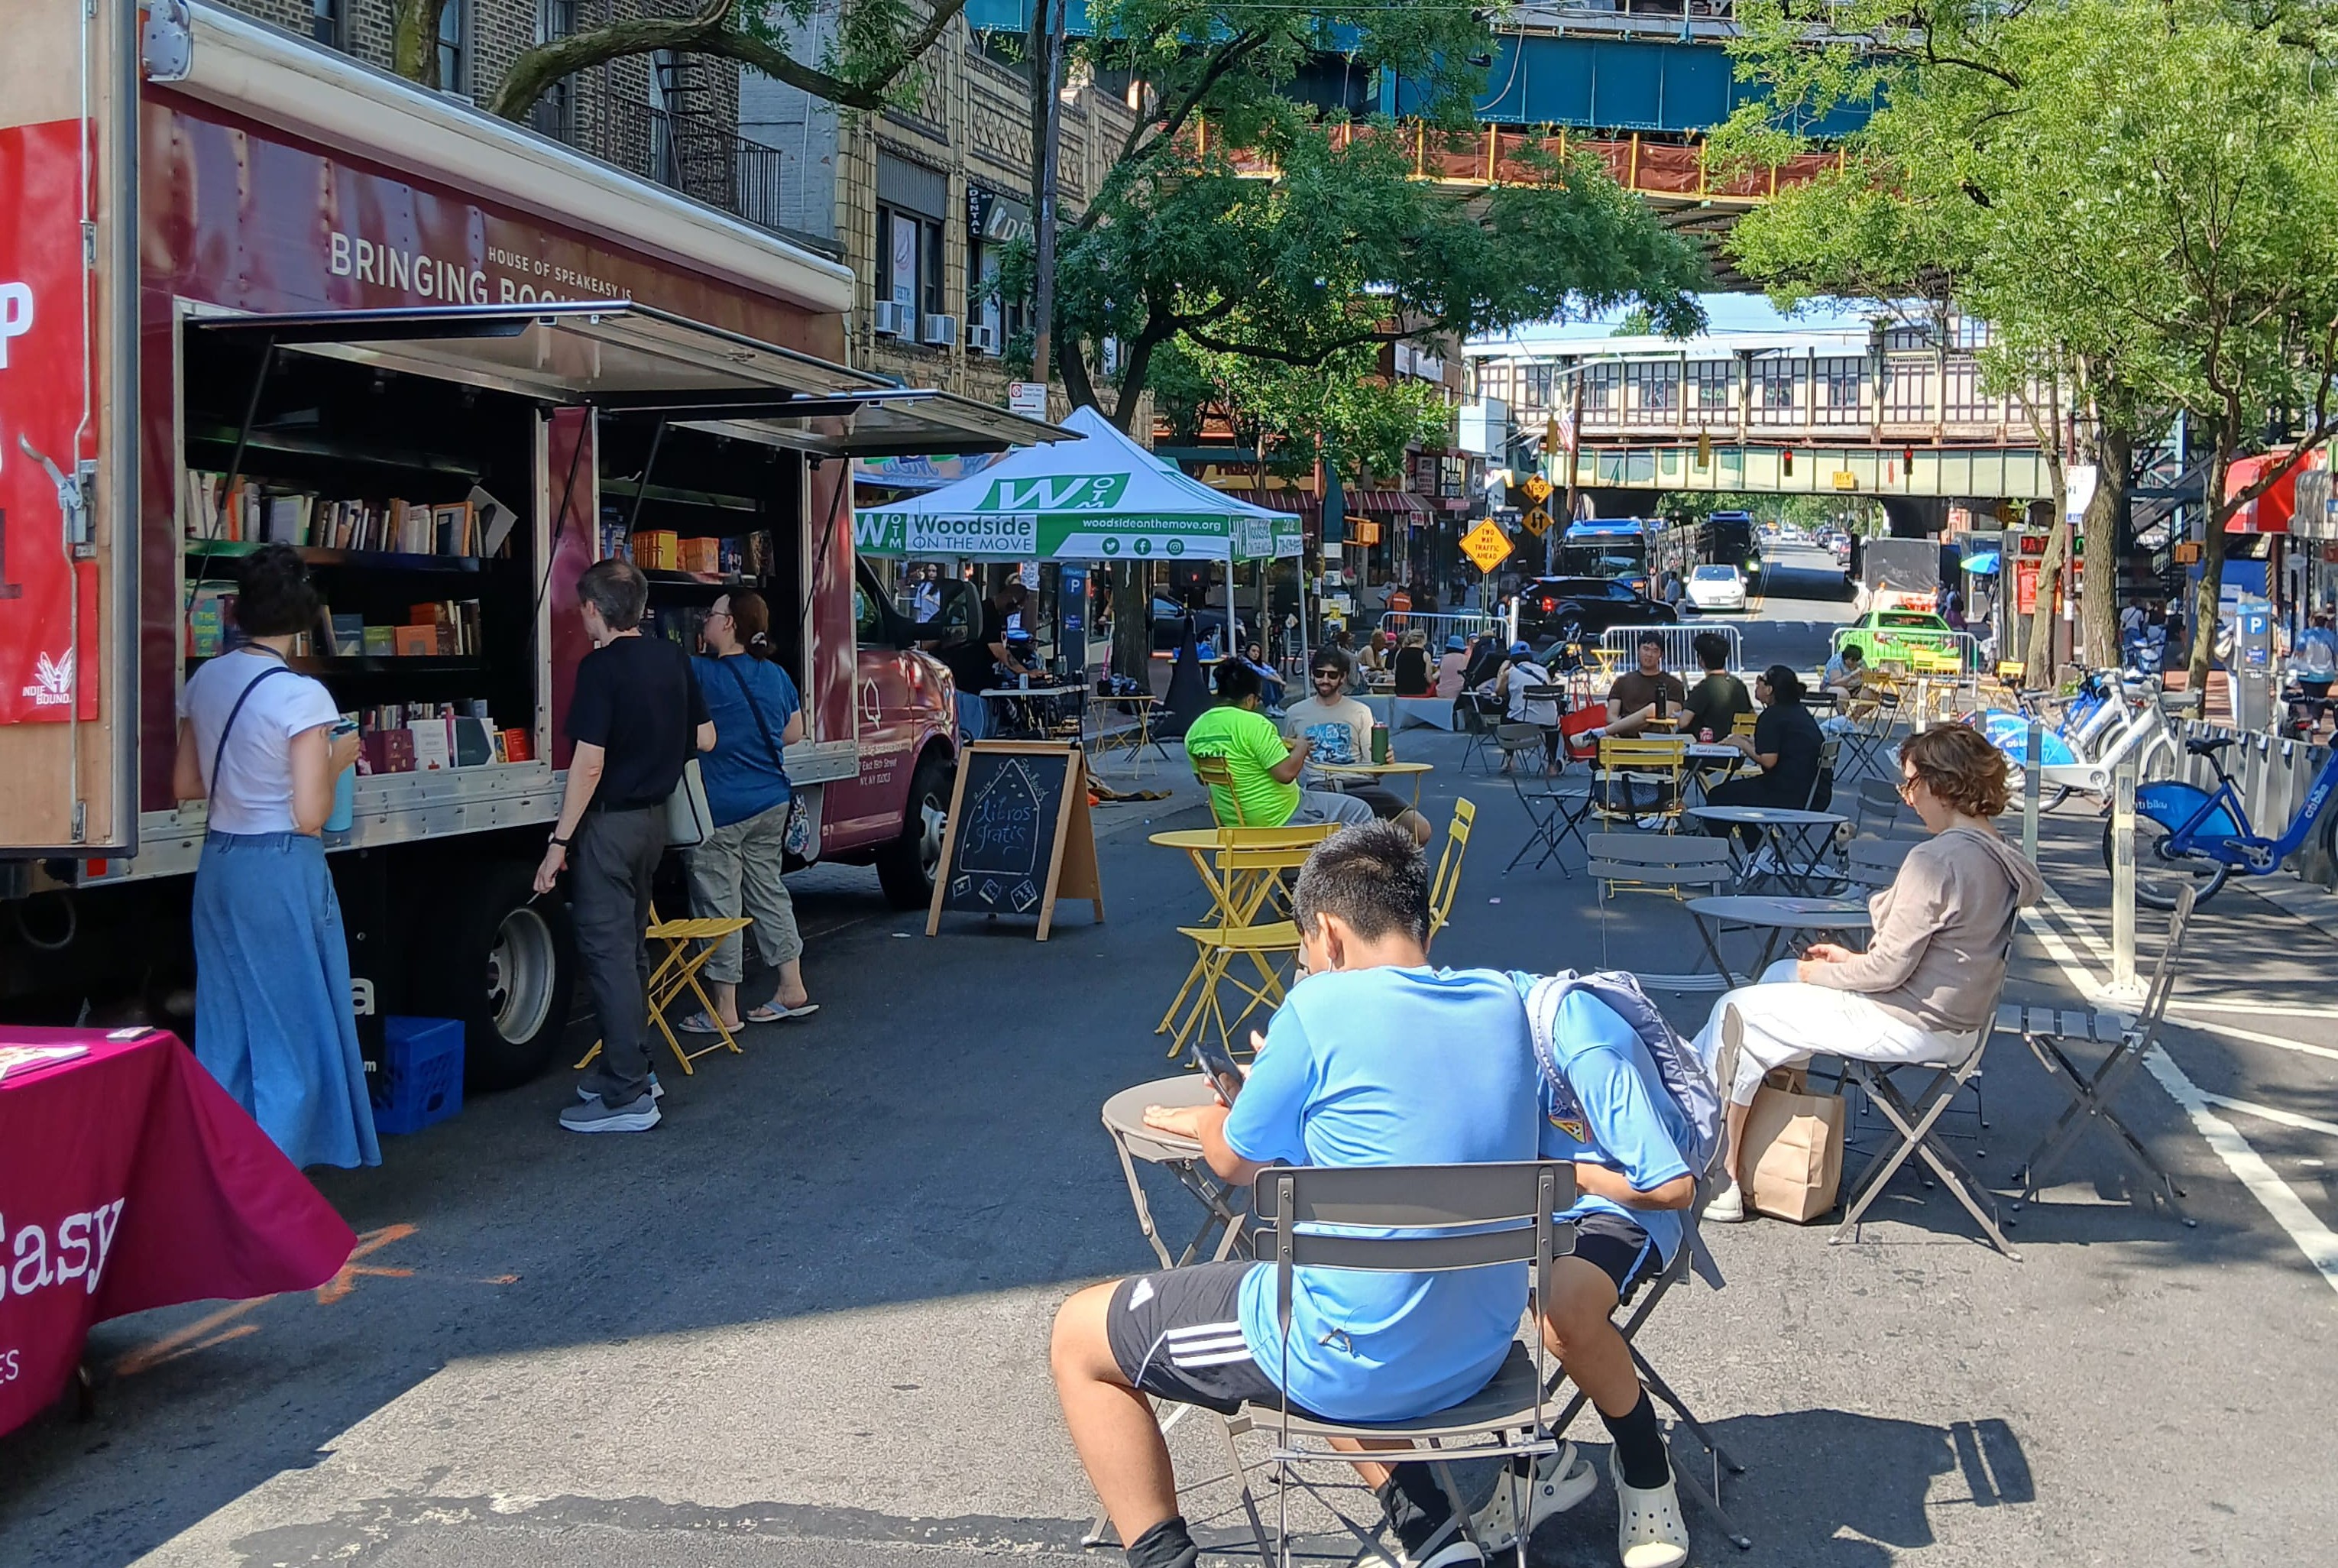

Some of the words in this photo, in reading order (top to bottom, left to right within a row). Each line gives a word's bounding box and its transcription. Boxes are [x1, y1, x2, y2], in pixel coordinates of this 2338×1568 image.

[969, 189, 980, 234] DENTAL
[331, 232, 487, 305] BRINGING
[488, 247, 529, 272] HOUSE
[535, 261, 550, 277] OF
[555, 267, 617, 297] SPEAKEASY
[622, 287, 632, 300] IS
[915, 515, 1031, 535] Woodside
[1083, 517, 1222, 532] woodsideonthemove.org
[913, 537, 939, 549] ON
[945, 537, 973, 549] THE
[980, 538, 1031, 550] MOVE
[1071, 578, 1080, 592] P
[2251, 617, 2262, 633] P
[22, 685, 46, 697] INDIE
[0, 1197, 125, 1301] asy
